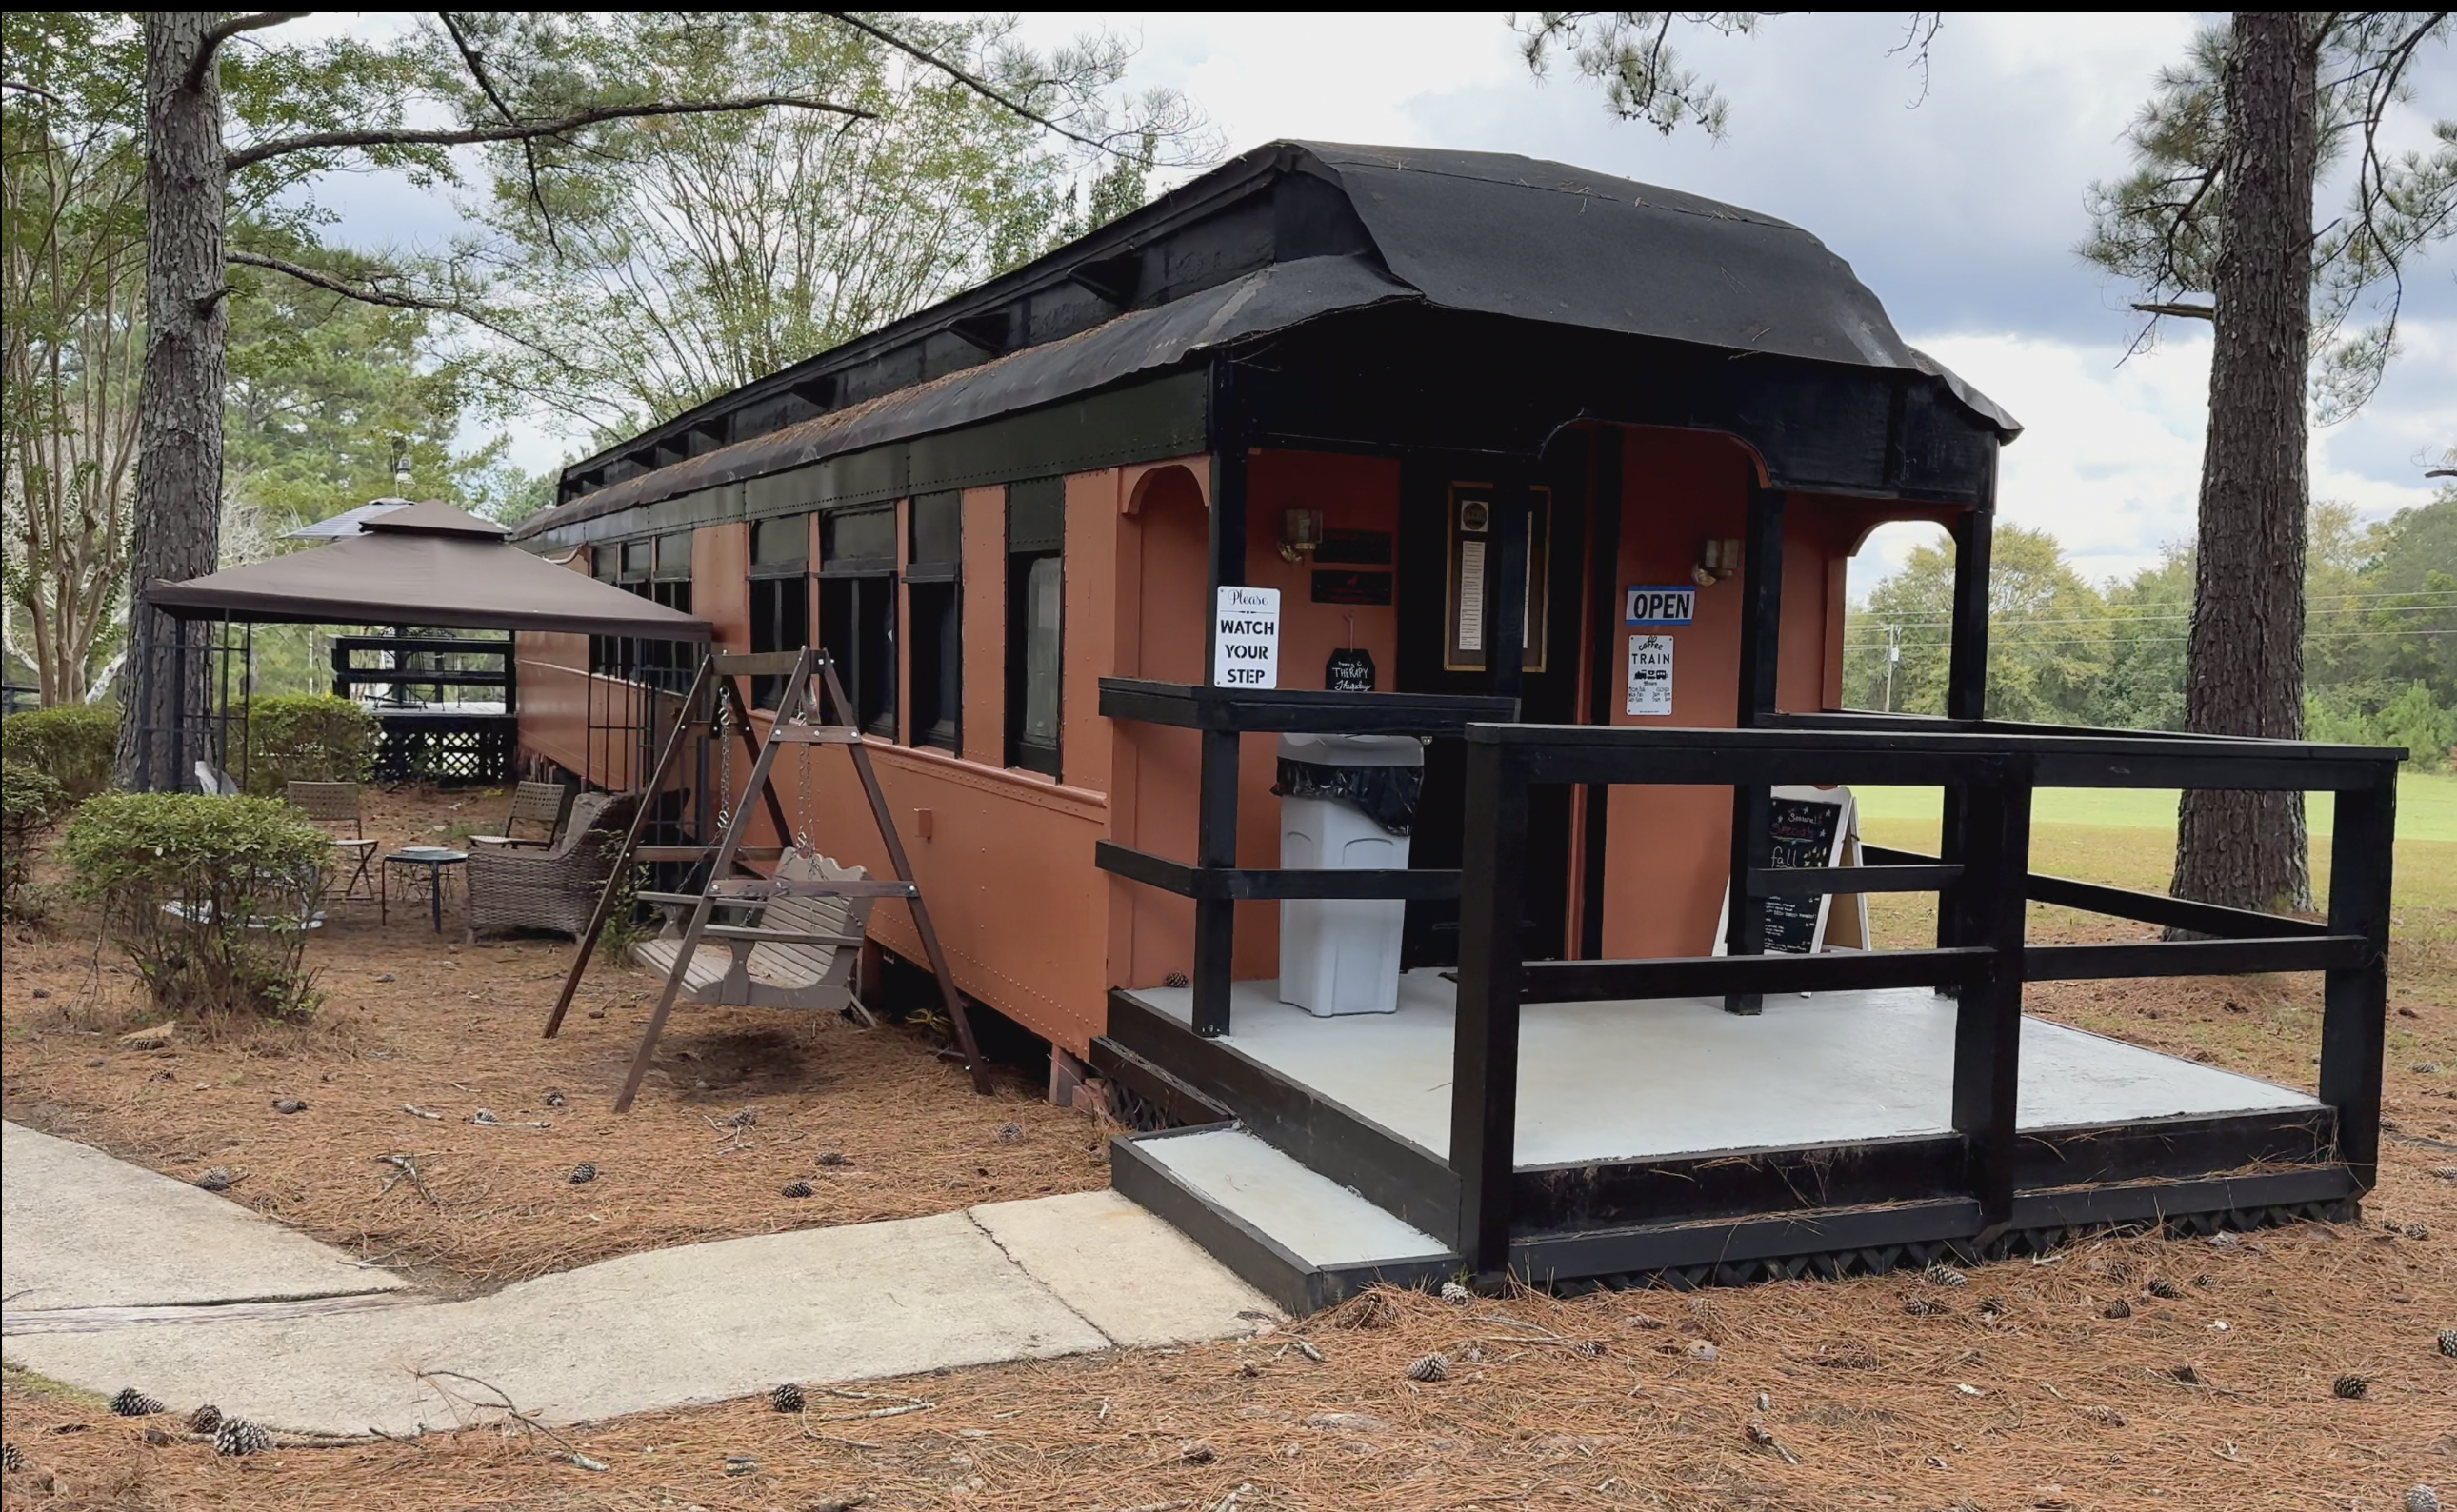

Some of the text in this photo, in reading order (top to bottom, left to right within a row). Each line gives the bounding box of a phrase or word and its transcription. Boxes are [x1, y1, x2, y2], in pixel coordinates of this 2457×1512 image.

[1228, 589, 1268, 606] Please
[1633, 593, 1690, 619] OPEN
[1220, 619, 1274, 635] WATCH
[1225, 644, 1268, 660] YOUR
[1631, 653, 1670, 665] TRAIN
[1228, 668, 1265, 684] STEP
[1332, 667, 1368, 679] THERAPY
